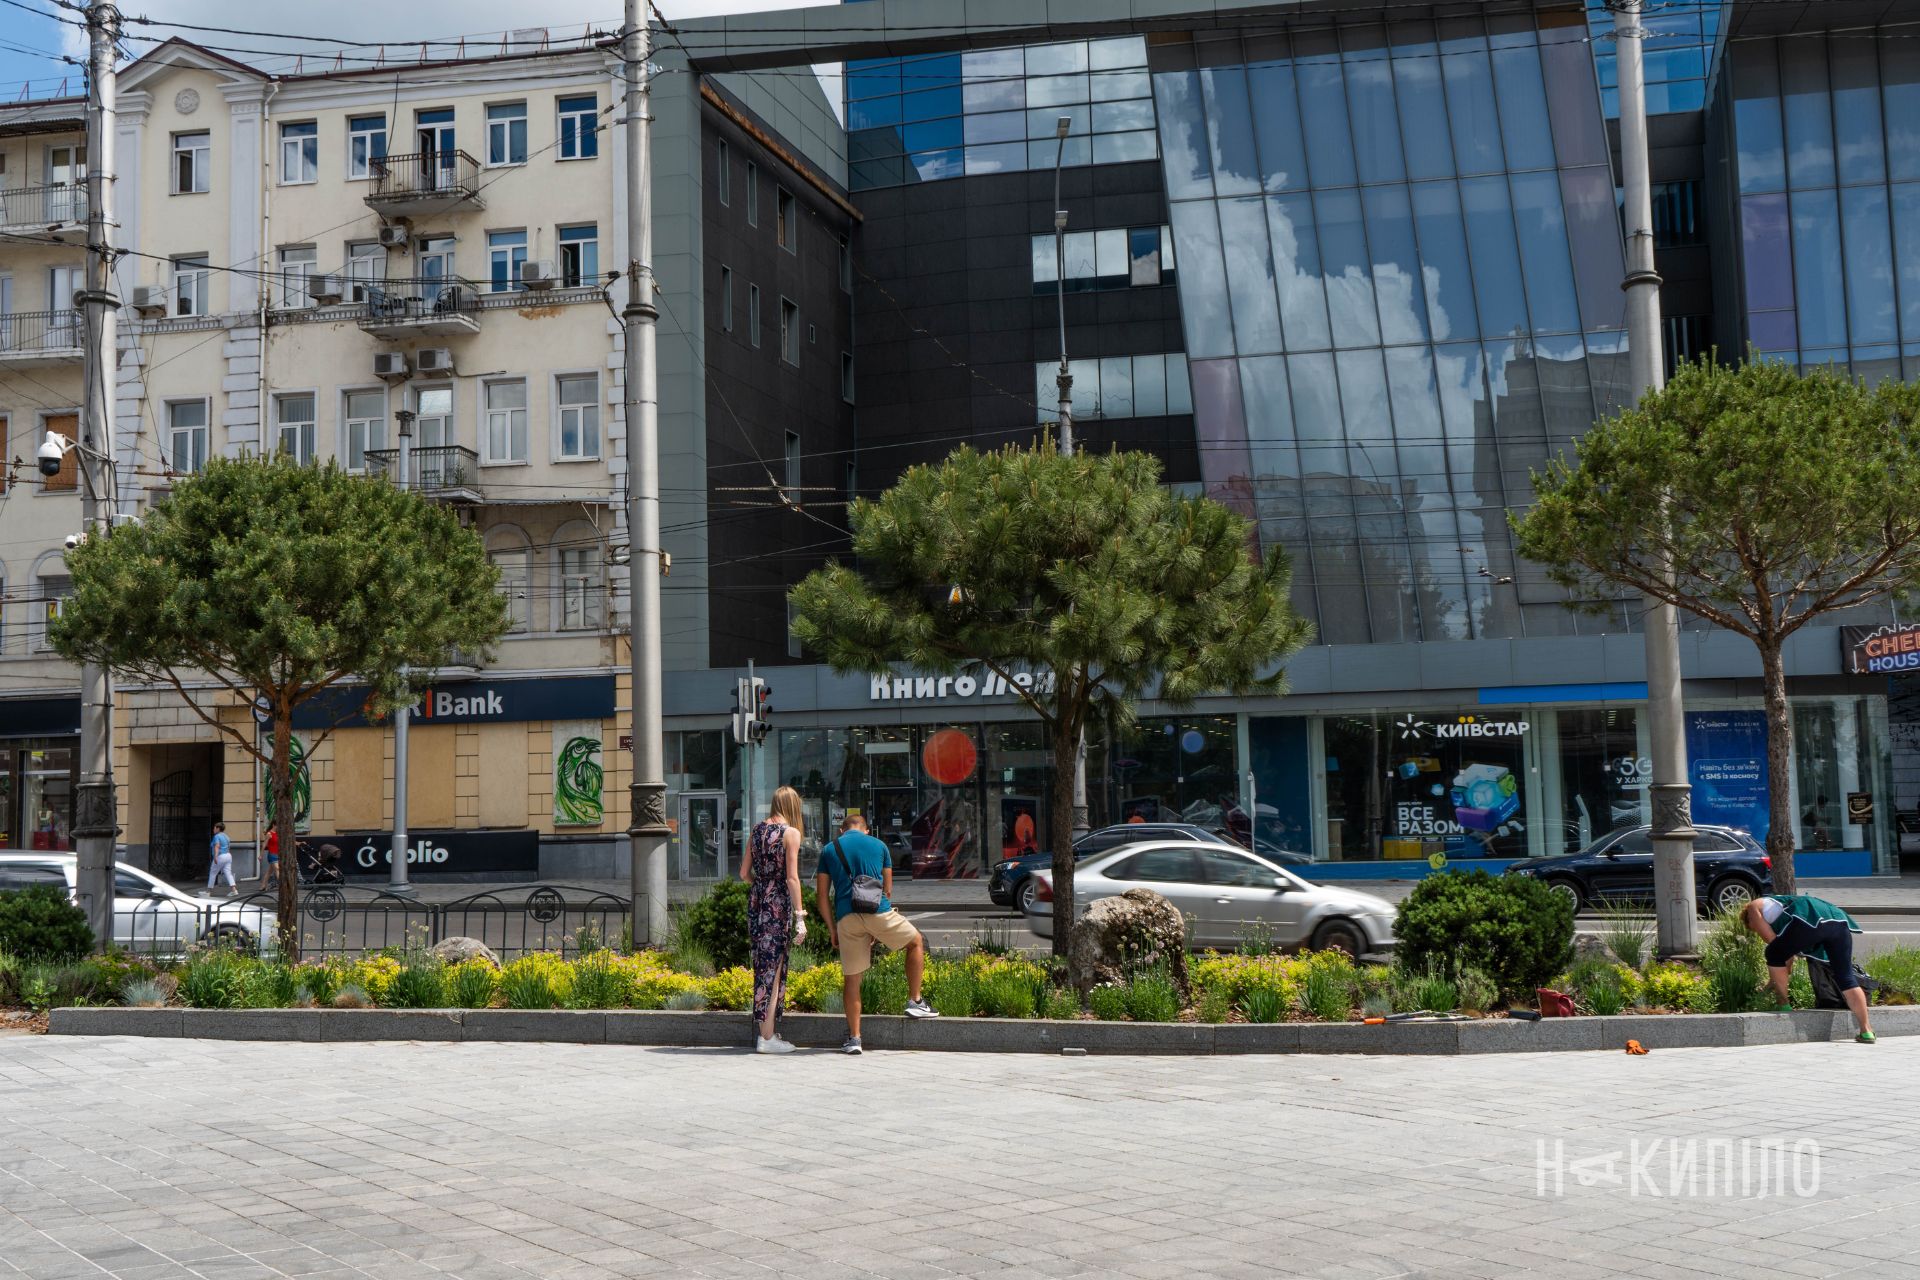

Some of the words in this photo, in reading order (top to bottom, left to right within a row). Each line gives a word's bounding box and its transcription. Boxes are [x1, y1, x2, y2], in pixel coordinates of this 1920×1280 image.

[1869, 652, 1920, 671] HOUS
[436, 690, 503, 716] Bank
[1437, 716, 1530, 738] КИЇВСТАР
[1624, 776, 1653, 784] ХАРКО
[1398, 806, 1434, 821] ВСЕ
[1399, 820, 1465, 835] РАЗОМ
